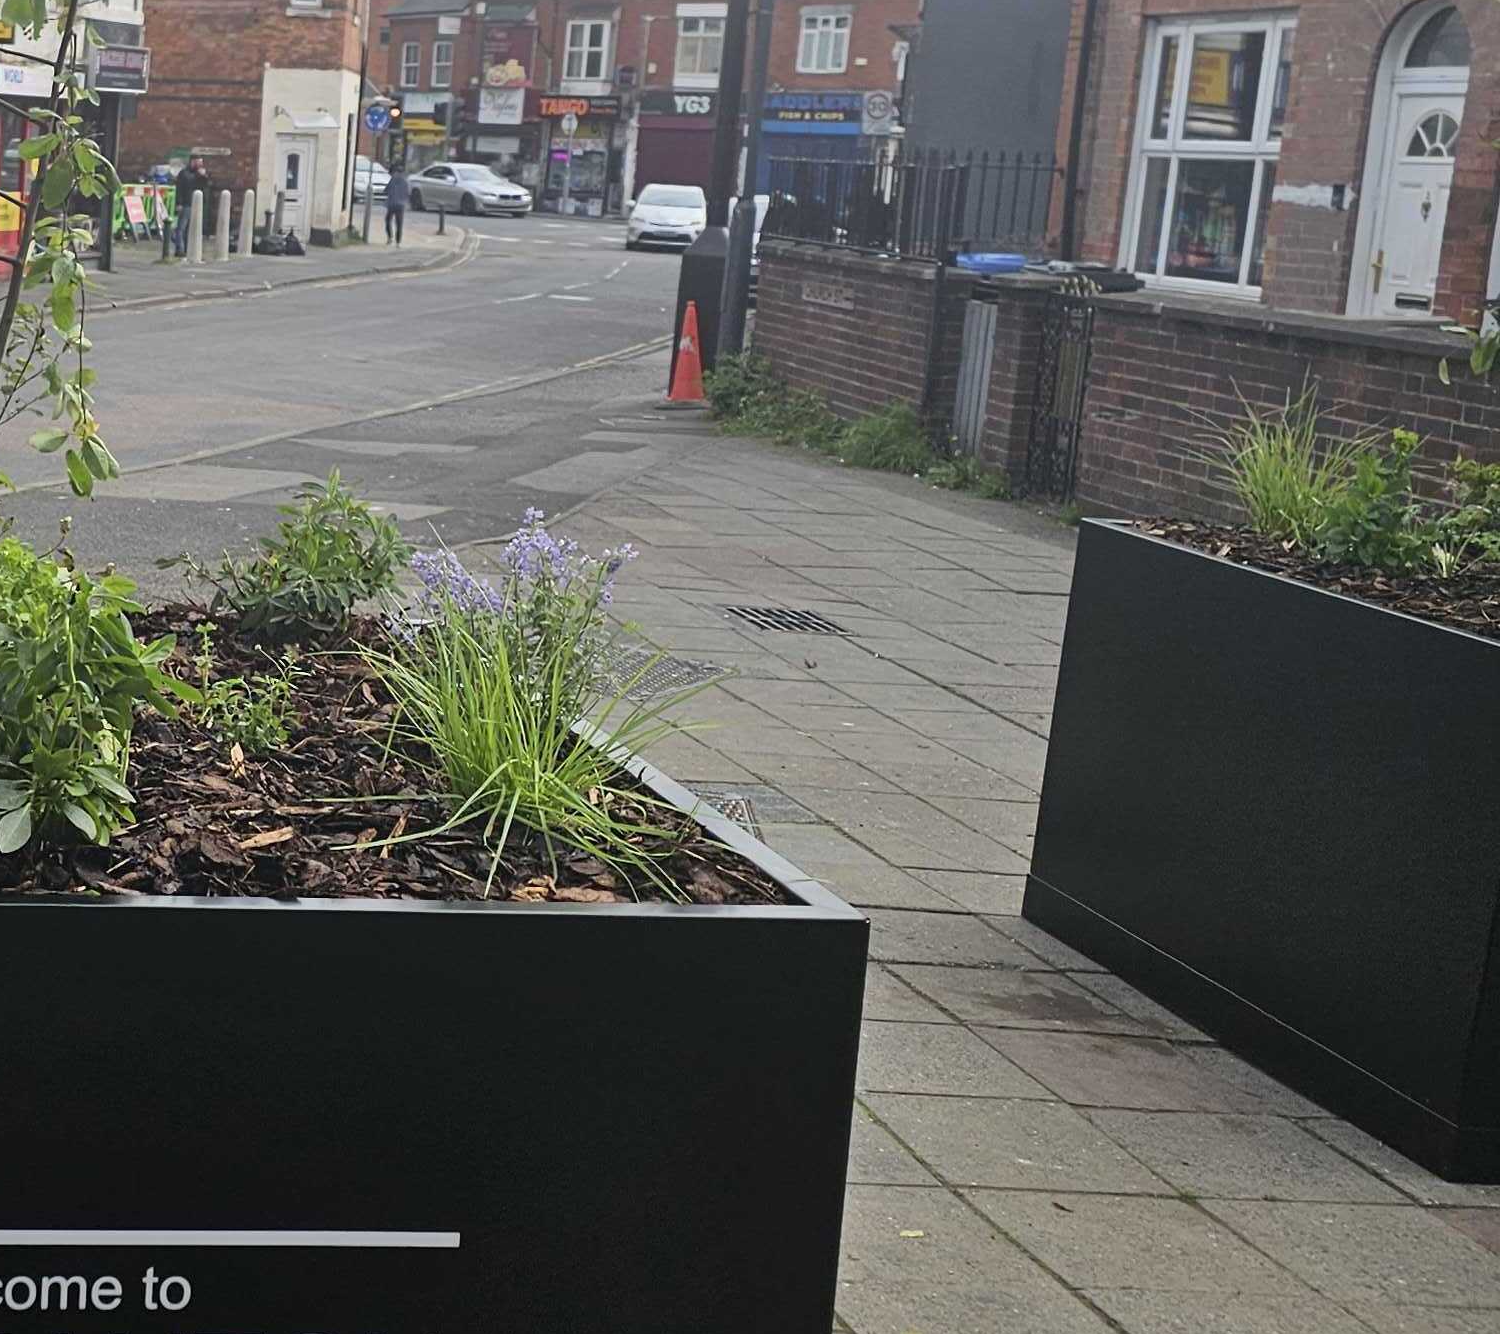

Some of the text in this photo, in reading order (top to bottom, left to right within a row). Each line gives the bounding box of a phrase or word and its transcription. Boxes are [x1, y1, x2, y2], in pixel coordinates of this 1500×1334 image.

[540, 98, 590, 115] TANGO
[673, 95, 711, 114] YG3
[778, 111, 802, 120] FISH
[814, 111, 845, 121] CHIPS
[142, 1264, 192, 1312] to
